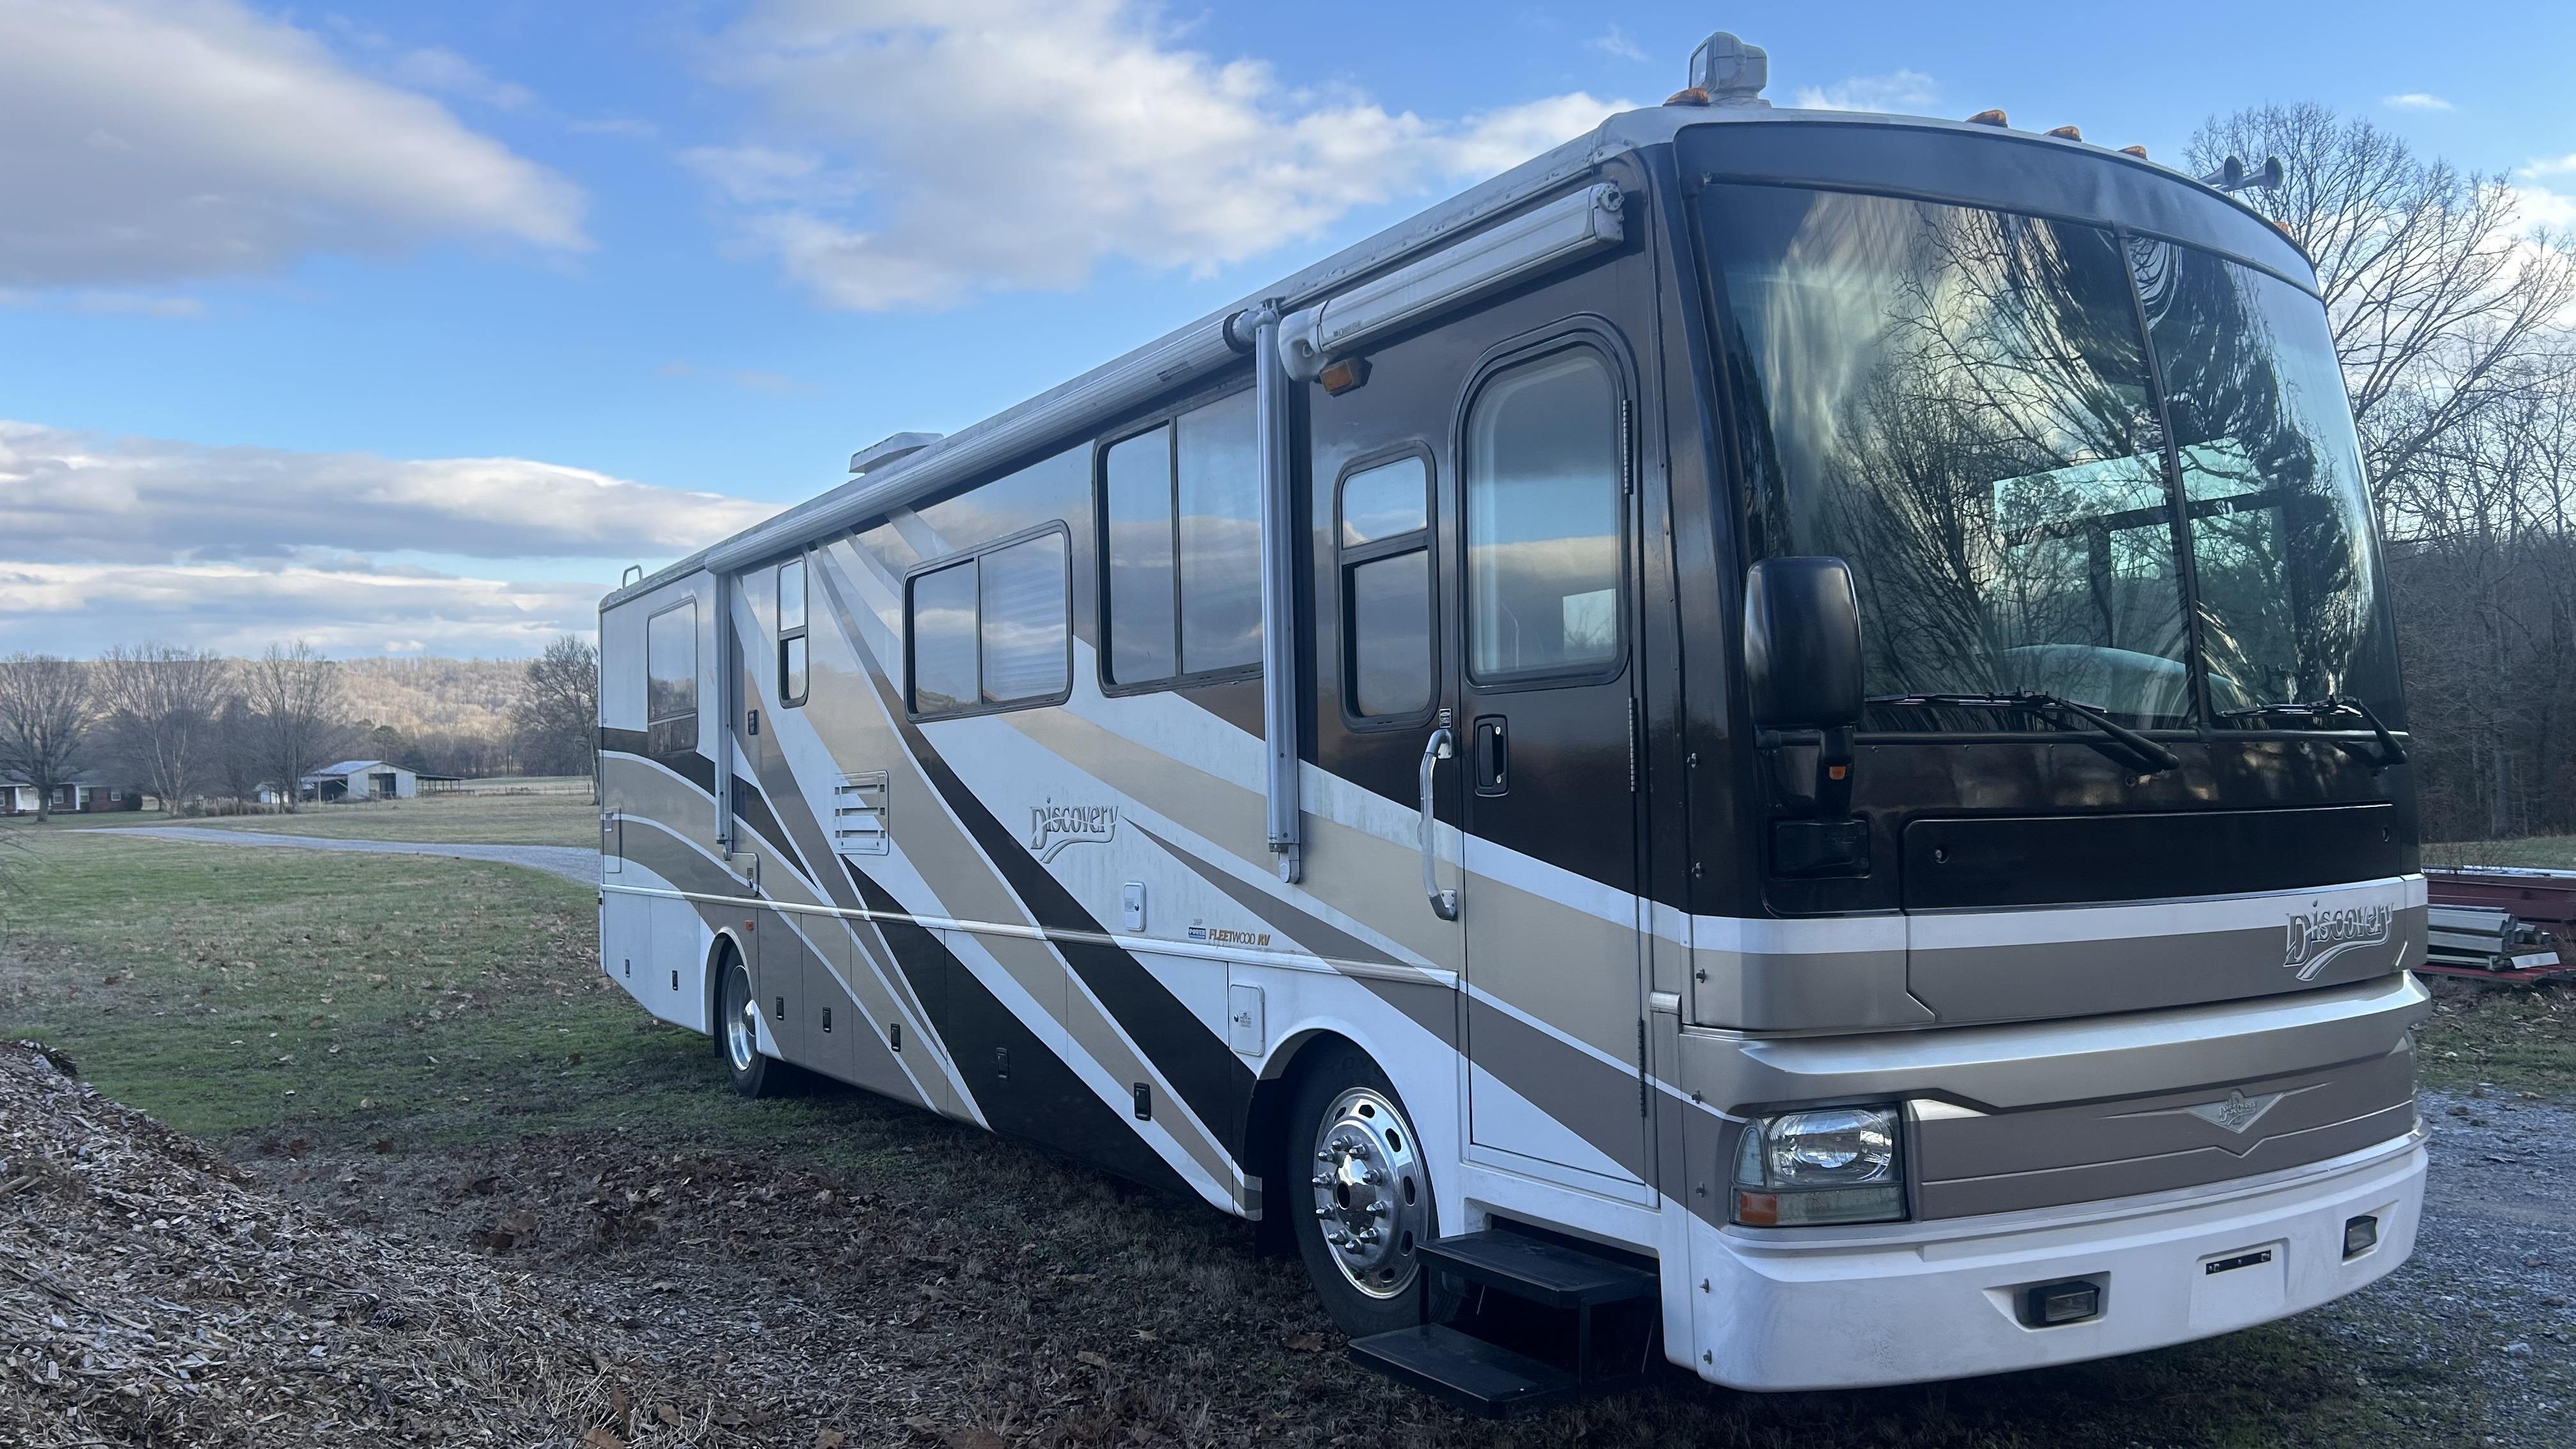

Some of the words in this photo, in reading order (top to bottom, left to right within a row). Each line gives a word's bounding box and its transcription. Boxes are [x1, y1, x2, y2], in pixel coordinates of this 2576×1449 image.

[1029, 795, 1119, 864] Discovery
[1209, 928, 1256, 945] FLEETWOOD
[1257, 933, 1271, 946] RV
[2283, 899, 2395, 981] Discovery
